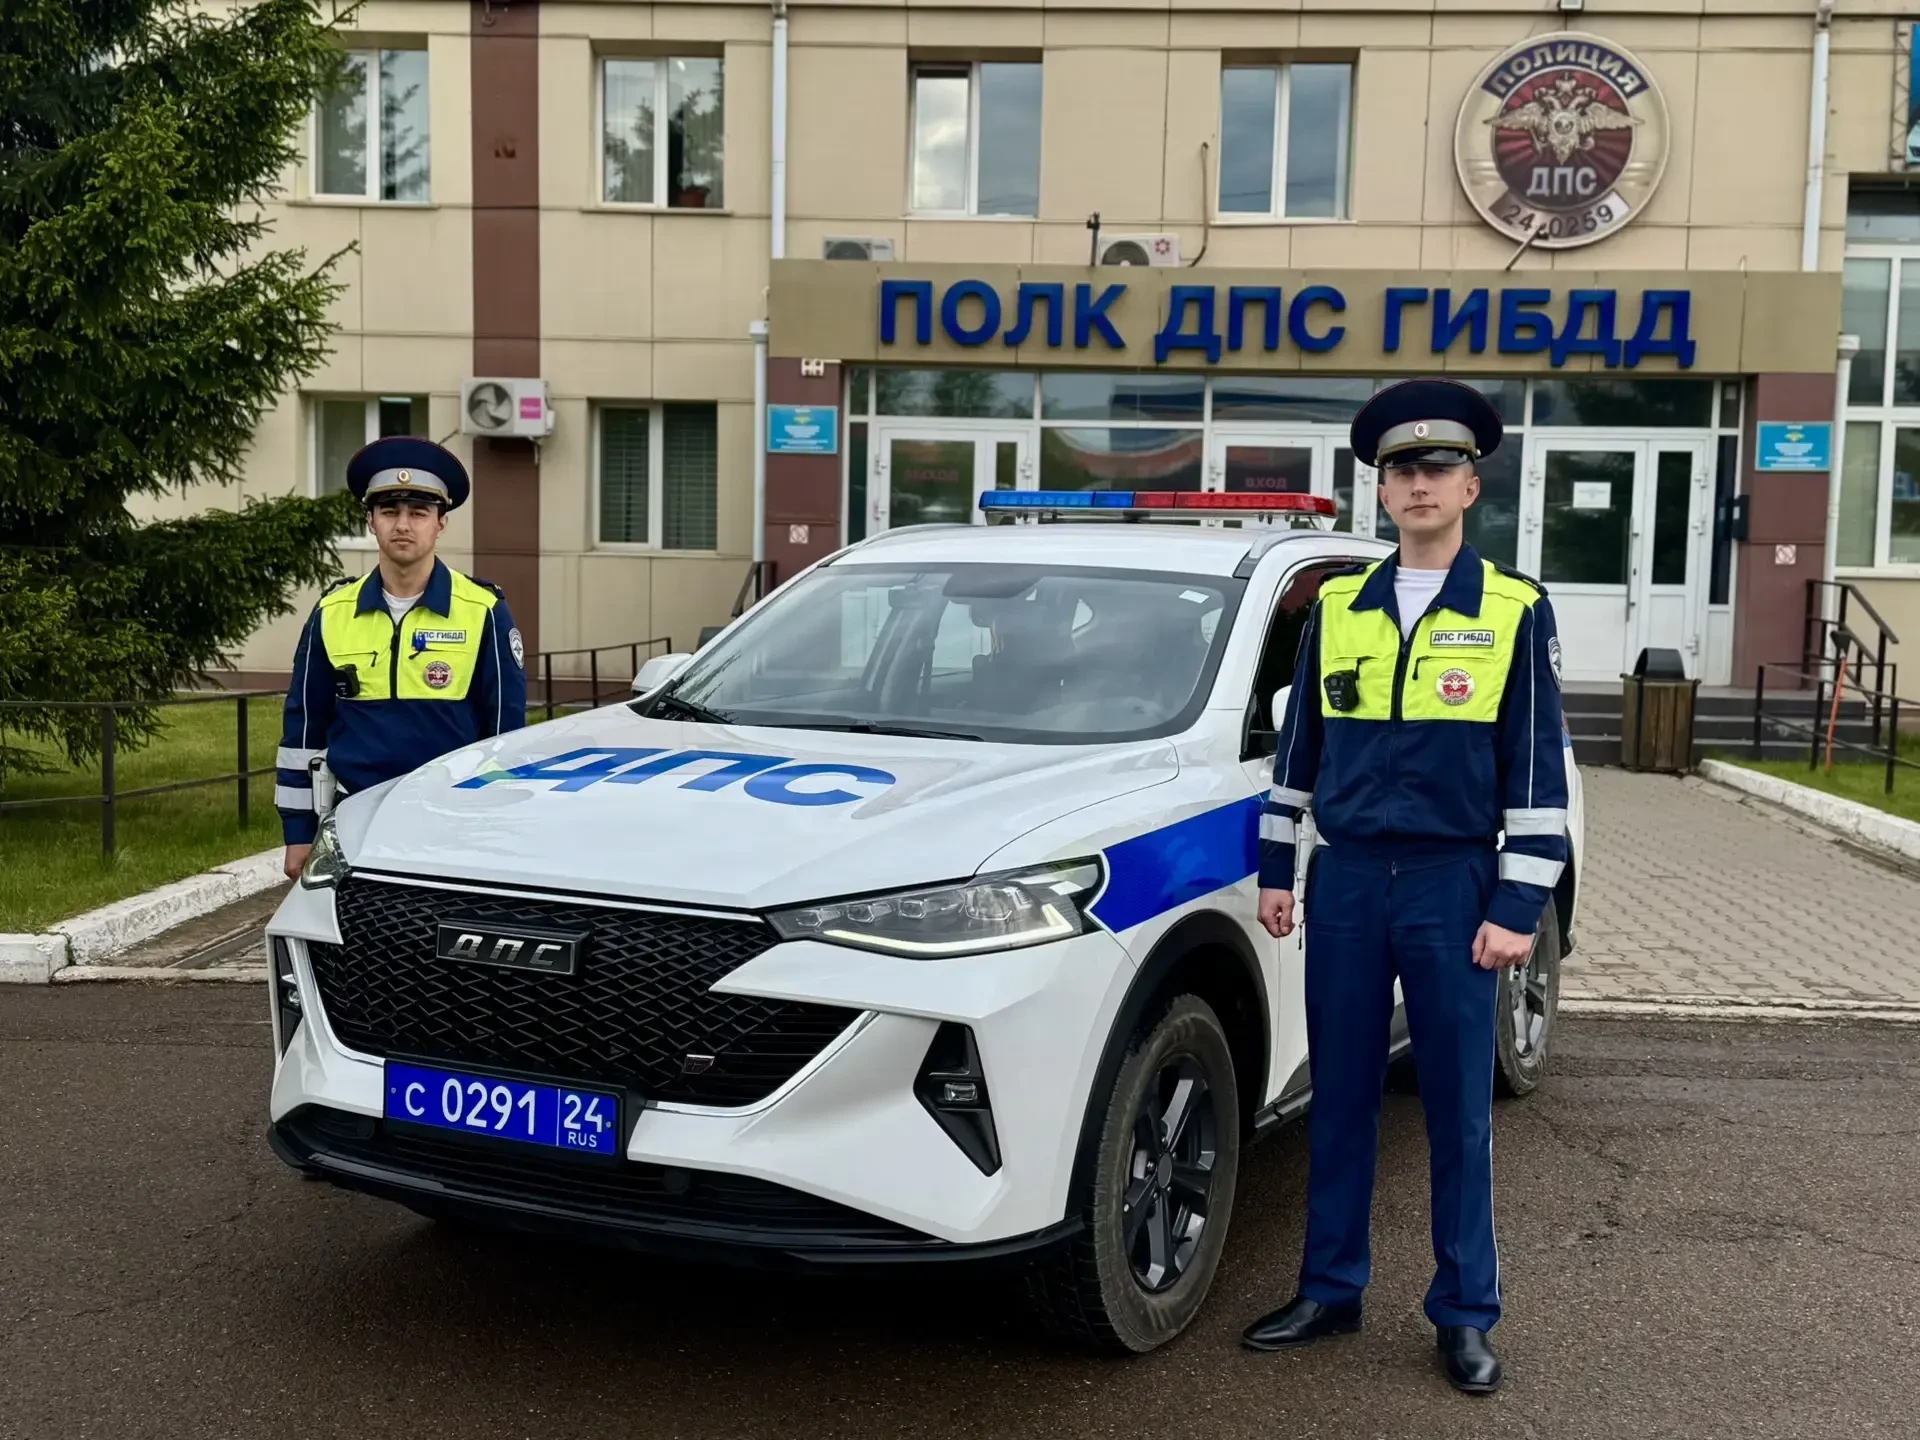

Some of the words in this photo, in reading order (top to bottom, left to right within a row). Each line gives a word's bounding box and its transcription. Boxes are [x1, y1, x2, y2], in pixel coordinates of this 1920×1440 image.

[1491, 43, 1642, 94] ПОЛИЦИЯ
[1526, 166, 1597, 196] ДПС
[881, 280, 1125, 347] ПОЛК
[1155, 286, 1346, 362] ДПС
[1385, 288, 1695, 367] ГИБДД
[1245, 477, 1287, 490] ВХОД
[436, 631, 464, 640] ГИБДД
[1433, 632, 1454, 641] ДПС
[1457, 632, 1491, 643] ГИБДД
[452, 747, 896, 806] ДПС
[447, 933, 563, 966] ДПС
[405, 1082, 426, 1116] С
[441, 1078, 536, 1135] 0291
[563, 1094, 603, 1133] 24
[567, 1131, 598, 1148] RUS
